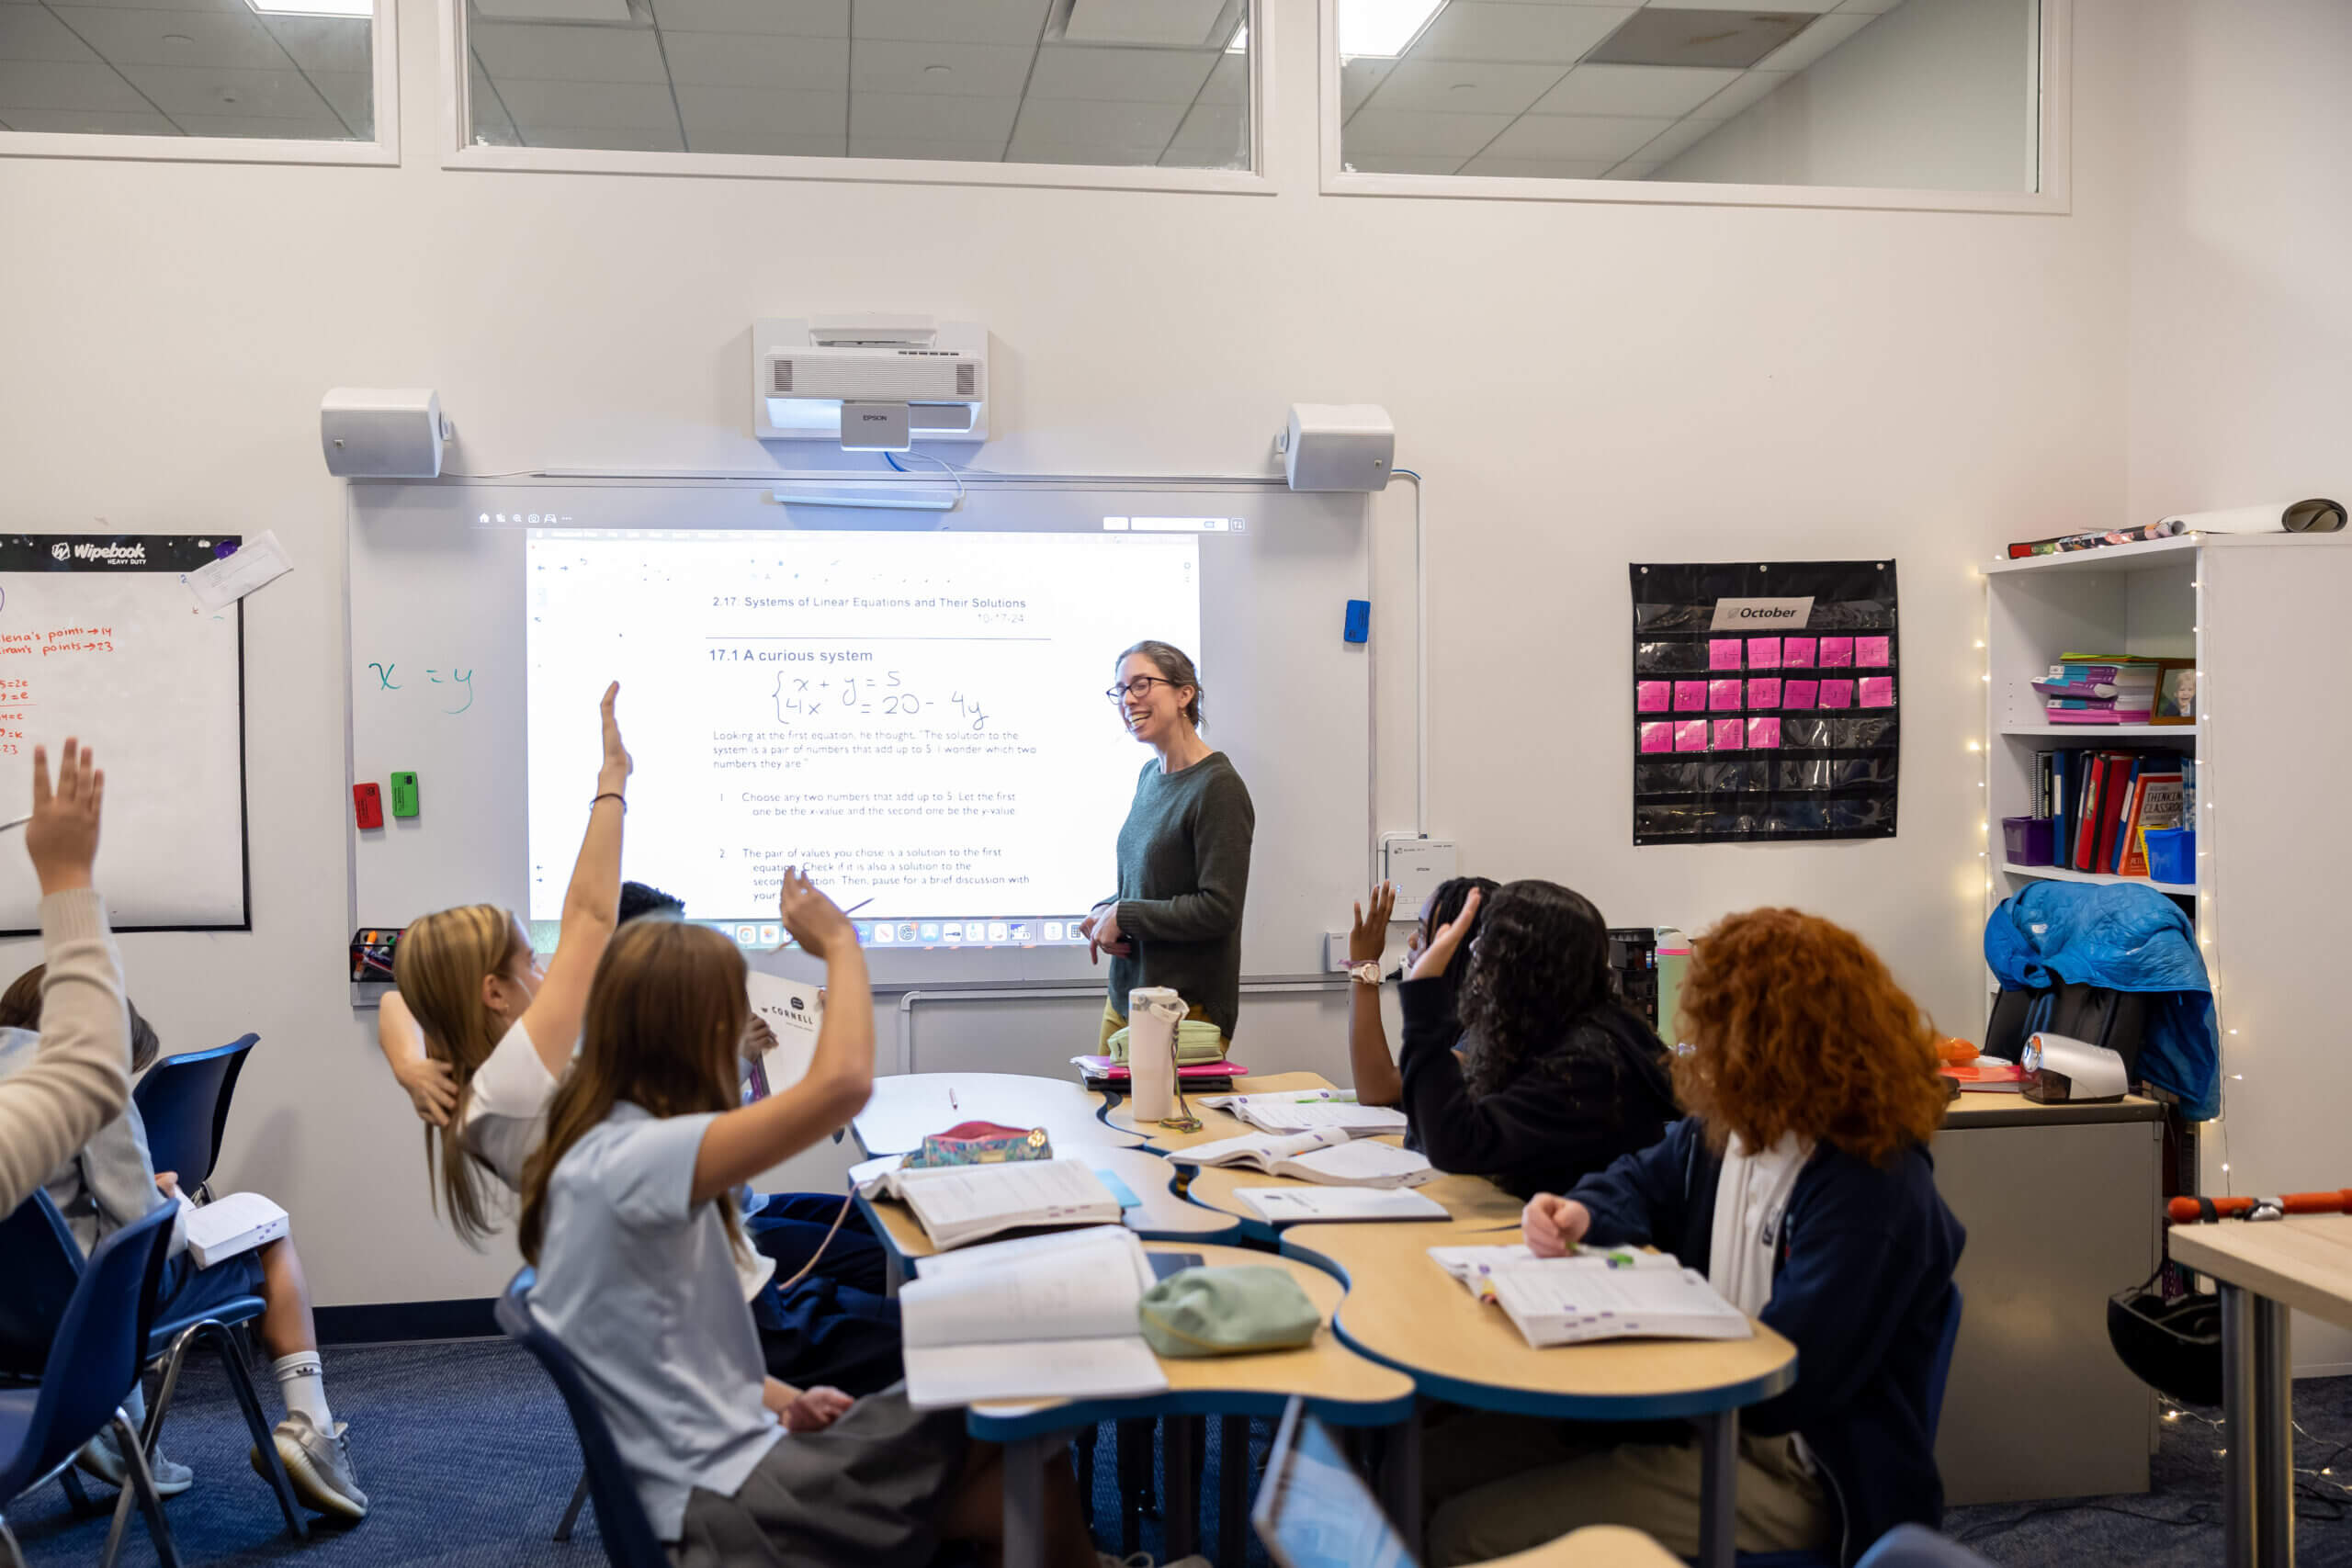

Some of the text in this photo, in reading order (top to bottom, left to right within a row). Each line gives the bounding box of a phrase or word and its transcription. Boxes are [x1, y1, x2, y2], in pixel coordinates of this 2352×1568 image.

[74, 543, 145, 561] Wipebook
[745, 597, 795, 609] Systems
[798, 597, 809, 606] of
[813, 598, 849, 607] Linear
[854, 598, 910, 608] Equations
[915, 598, 935, 607] and
[940, 598, 968, 607] Their
[972, 598, 1026, 608] Solutions
[1740, 608, 1797, 618] October
[42, 642, 81, 657] points
[710, 649, 873, 664] 17.1 A curious system
[882, 694, 920, 714] 20
[714, 731, 752, 743] Looking
[757, 731, 765, 740] at
[769, 731, 786, 740] the
[789, 730, 808, 740] first
[860, 731, 871, 740] he
[946, 729, 985, 740] solution
[989, 731, 1000, 740] to
[1003, 731, 1019, 740] the
[714, 746, 748, 757] system
[752, 745, 759, 754] is
[771, 746, 789, 757] pair
[794, 744, 803, 754] of
[807, 745, 849, 754] numbers
[853, 744, 872, 754] that
[875, 745, 893, 754] add
[896, 746, 909, 757] up
[911, 746, 922, 754] to
[944, 745, 982, 754] wonder
[986, 745, 1014, 754] which
[1017, 746, 1037, 754] two
[714, 760, 757, 769] numbers
[761, 761, 782, 771] they
[742, 792, 781, 802] Choose
[784, 794, 802, 804] any
[805, 793, 824, 802] two
[828, 793, 871, 802] numbers
[874, 792, 893, 801] that
[897, 792, 914, 801] add
[918, 794, 929, 804] up
[933, 793, 944, 801] to
[958, 792, 974, 801] Let
[978, 792, 994, 801] the
[997, 792, 1015, 801] first
[2146, 792, 2183, 803] THINKIN
[752, 807, 772, 817] one
[775, 807, 787, 817] be
[790, 807, 807, 817] the
[809, 807, 844, 817] x-value
[847, 807, 865, 817] and
[868, 807, 884, 816] the
[888, 806, 922, 816] second
[925, 807, 944, 816] one
[947, 807, 959, 816] be
[963, 807, 978, 816] the
[742, 848, 762, 858] The
[765, 850, 783, 860] pair
[787, 848, 797, 858] of
[801, 848, 831, 858] values
[834, 850, 850, 860] you
[855, 848, 884, 857] chose
[907, 847, 946, 857] solution
[949, 848, 960, 857] to
[964, 847, 980, 856] the
[982, 846, 1002, 856] first
[802, 862, 833, 872] Check
[838, 862, 843, 871] if
[847, 862, 854, 871] it
[856, 862, 864, 871] is
[867, 862, 888, 871] also
[890, 863, 896, 871] a
[899, 862, 938, 871] solution
[942, 863, 953, 871] to
[956, 862, 972, 871] the
[872, 877, 900, 886] pause
[903, 875, 918, 885] for
[930, 875, 953, 885] brief
[956, 874, 1004, 885] discussion
[1008, 874, 1030, 884] with
[753, 893, 776, 902] your
